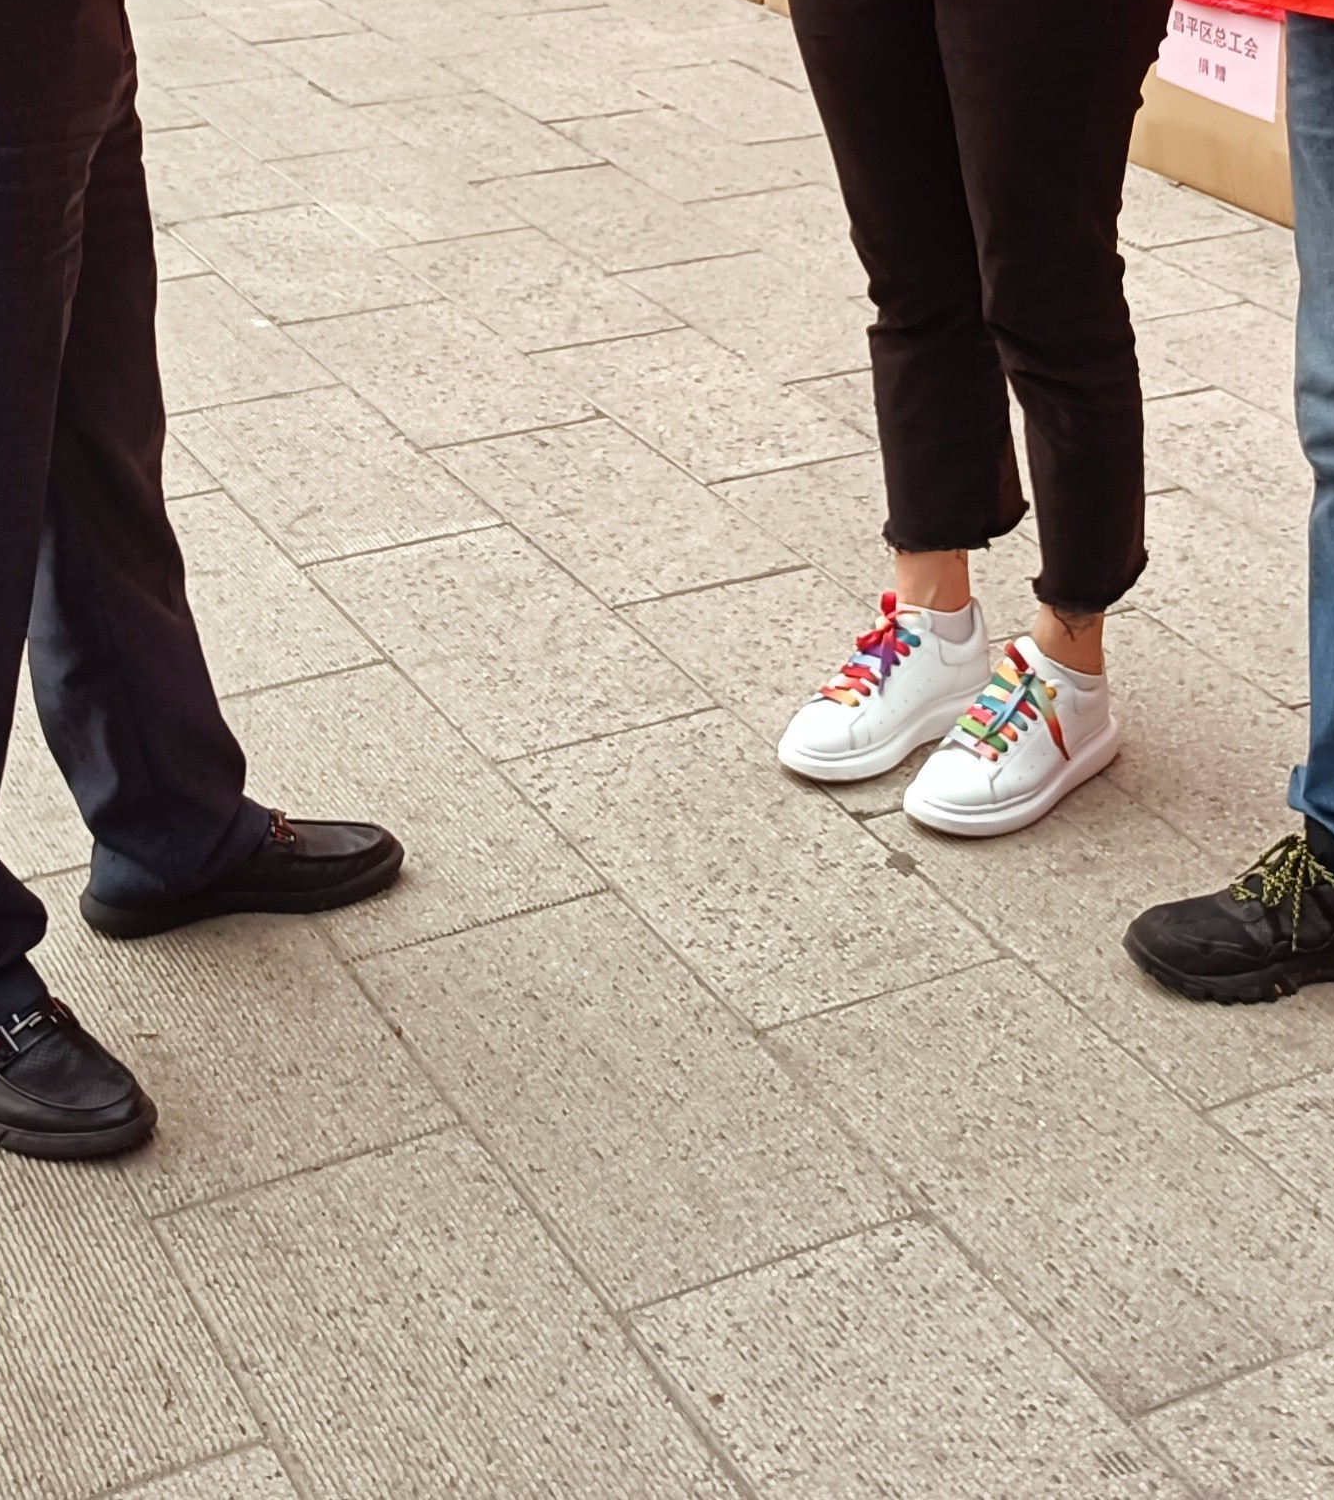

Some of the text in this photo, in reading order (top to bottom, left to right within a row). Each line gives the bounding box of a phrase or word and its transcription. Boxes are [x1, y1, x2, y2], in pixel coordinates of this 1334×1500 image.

[1173, 11, 1258, 60] 昌平区总工会
